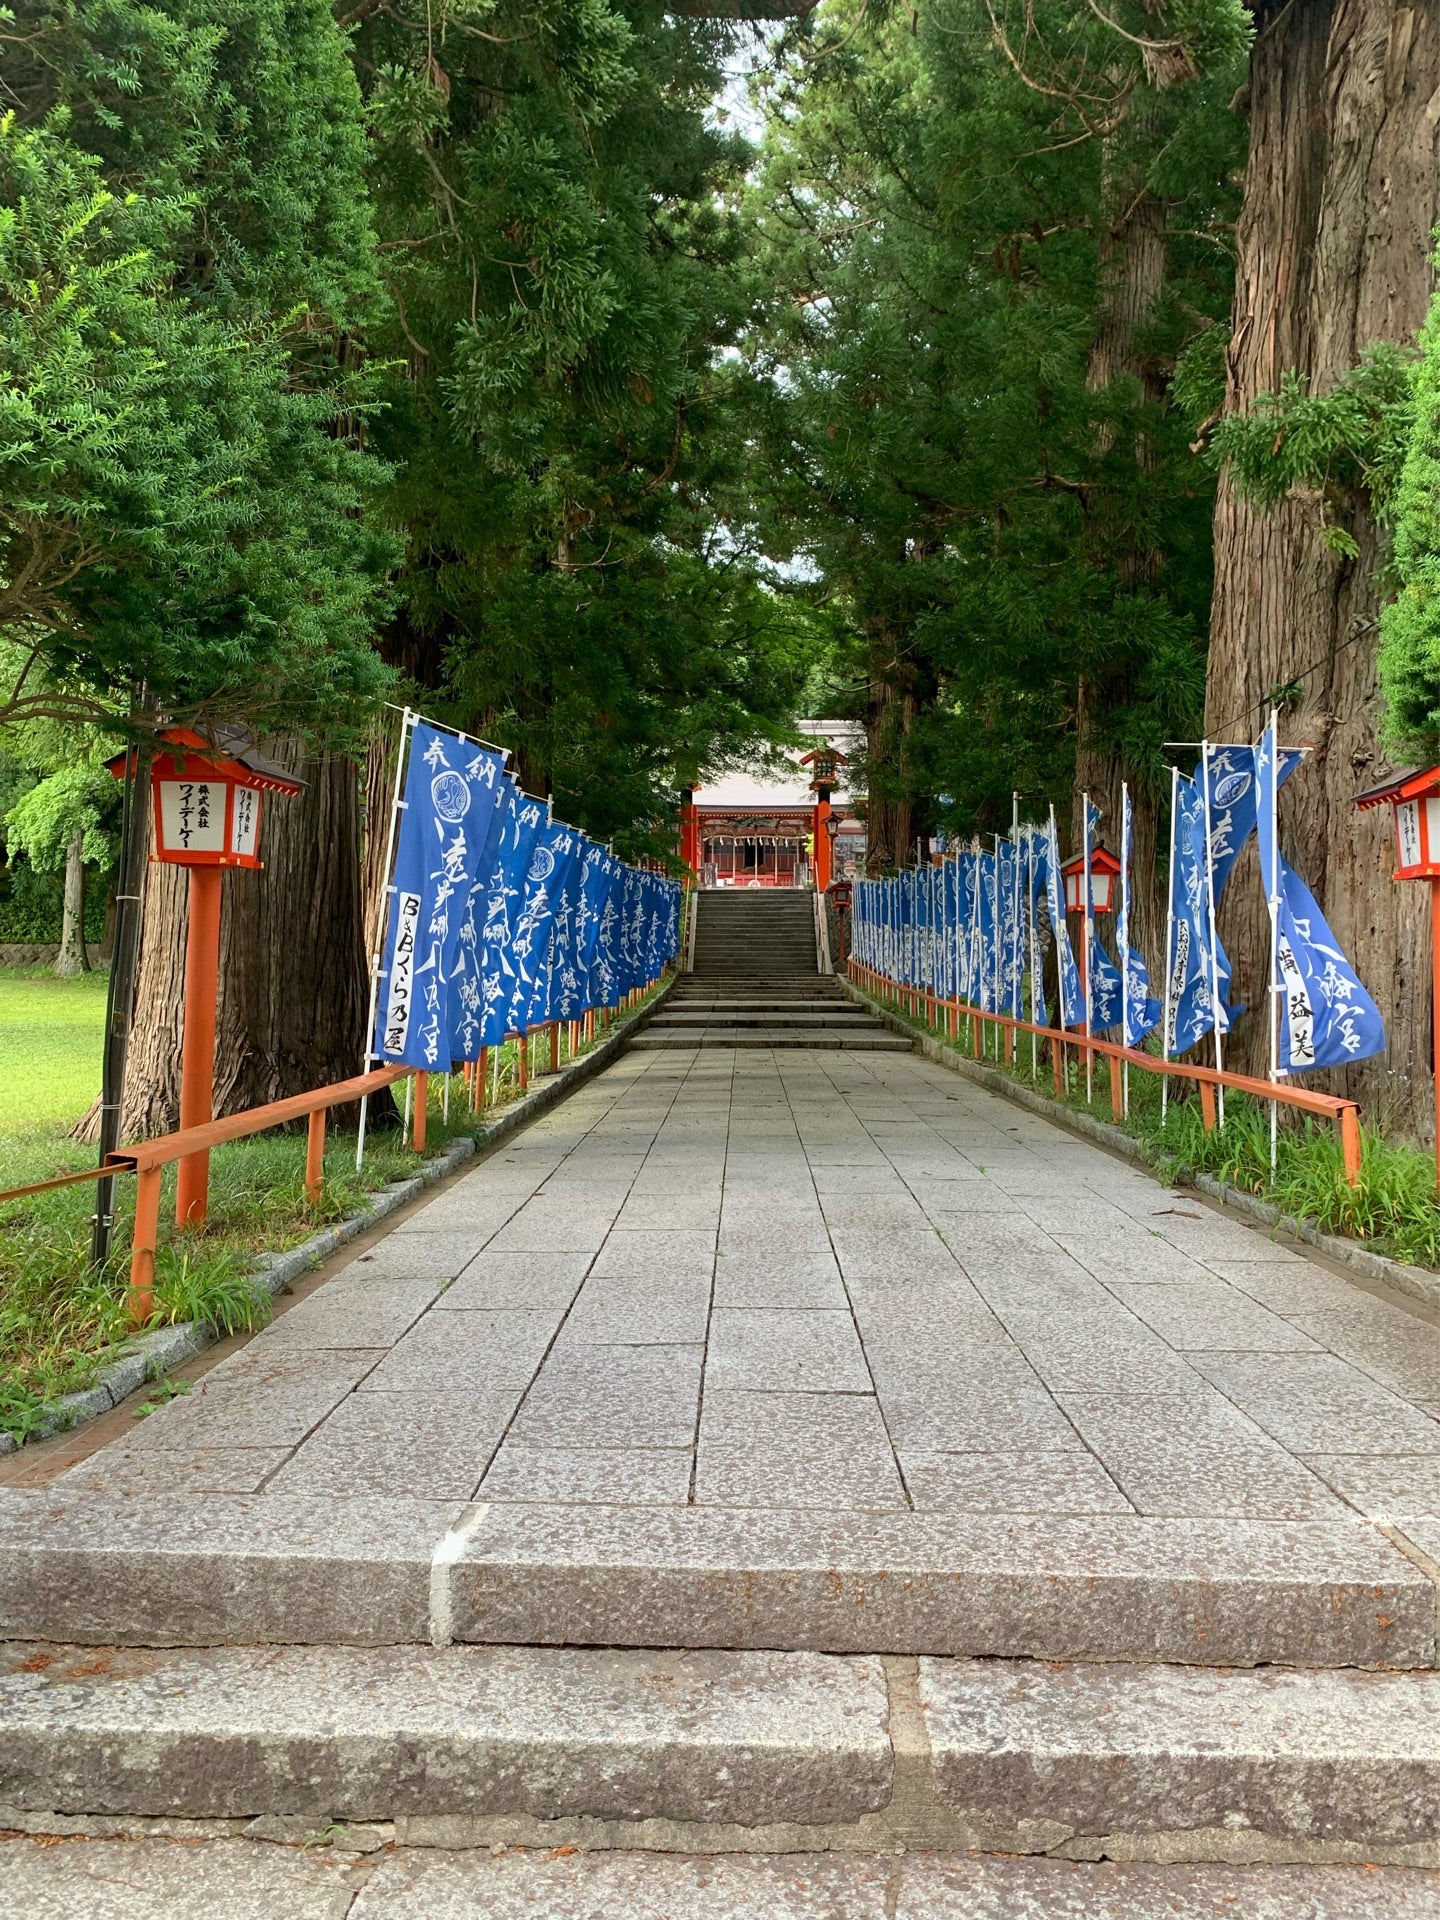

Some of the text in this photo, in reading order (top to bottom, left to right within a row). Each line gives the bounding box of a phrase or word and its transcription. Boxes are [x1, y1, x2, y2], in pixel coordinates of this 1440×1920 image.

[179, 784, 195, 848] ワイデーケー
[198, 784, 210, 828] 株式会社
